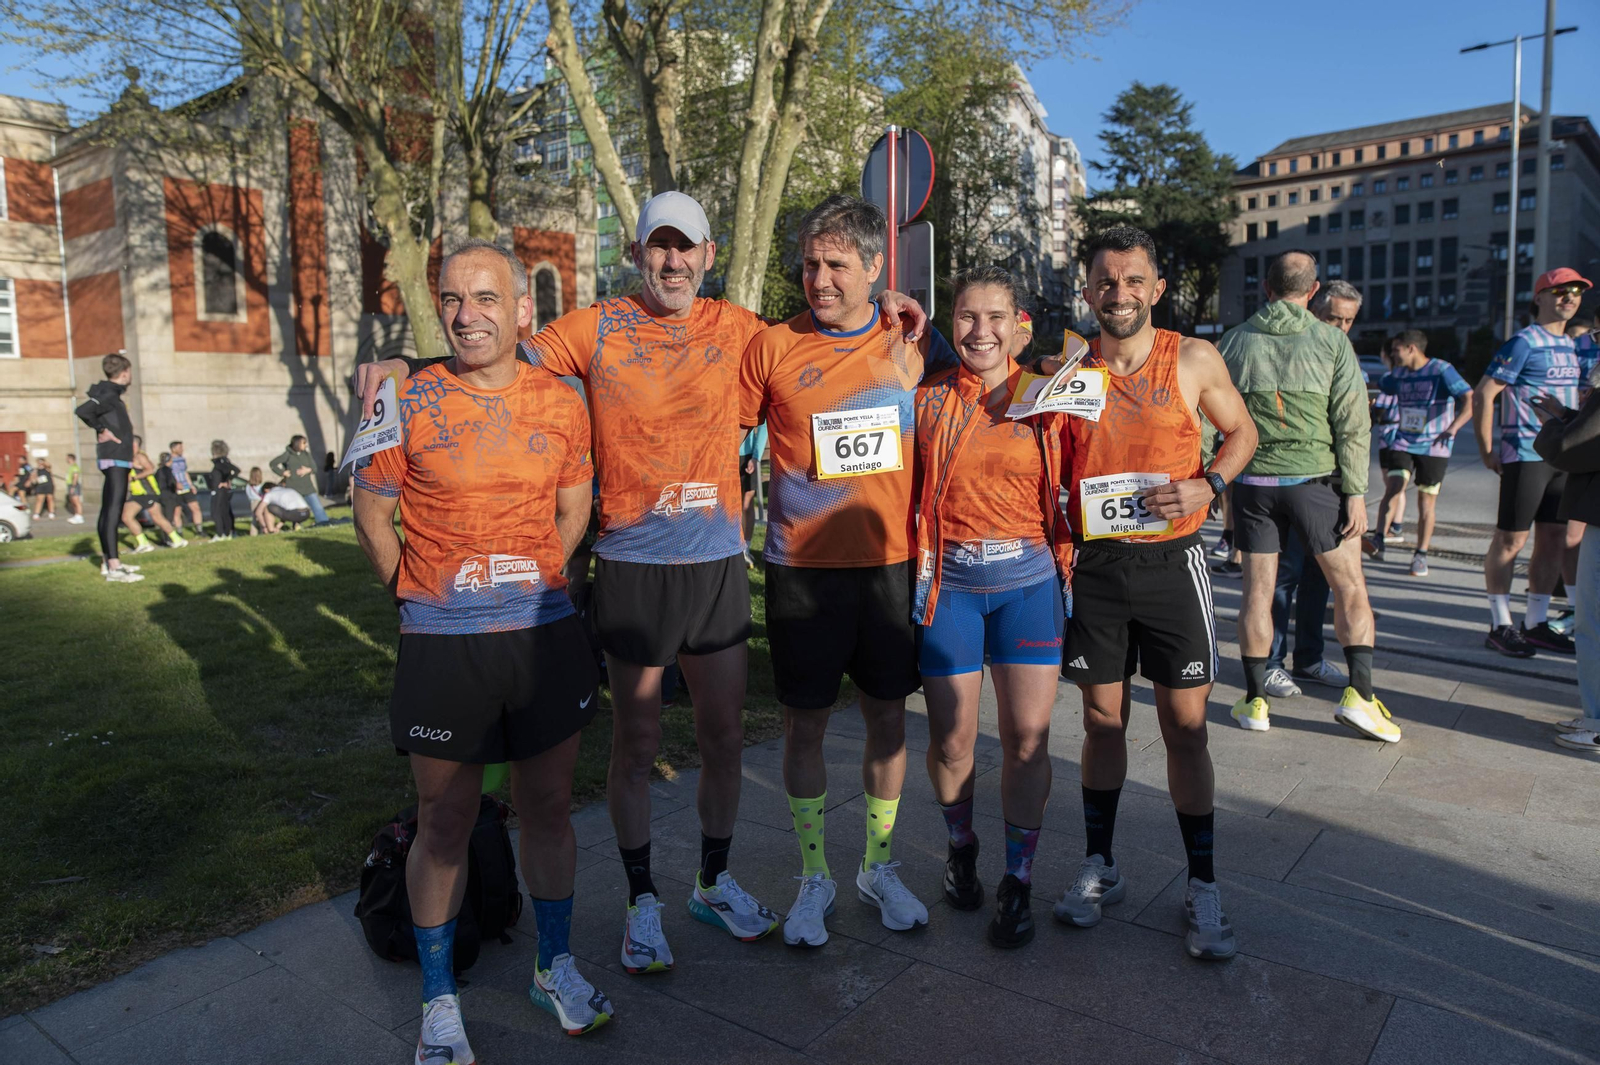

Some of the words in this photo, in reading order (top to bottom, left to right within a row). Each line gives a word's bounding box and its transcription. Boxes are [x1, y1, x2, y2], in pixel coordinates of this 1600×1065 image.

[835, 431, 884, 459] 667
[840, 461, 882, 472] Santiago
[1101, 496, 1151, 520] 659
[1110, 522, 1145, 533] Miguel
[987, 539, 1023, 554] ESPOTRUCK
[495, 559, 540, 574] ESPOTRUCK
